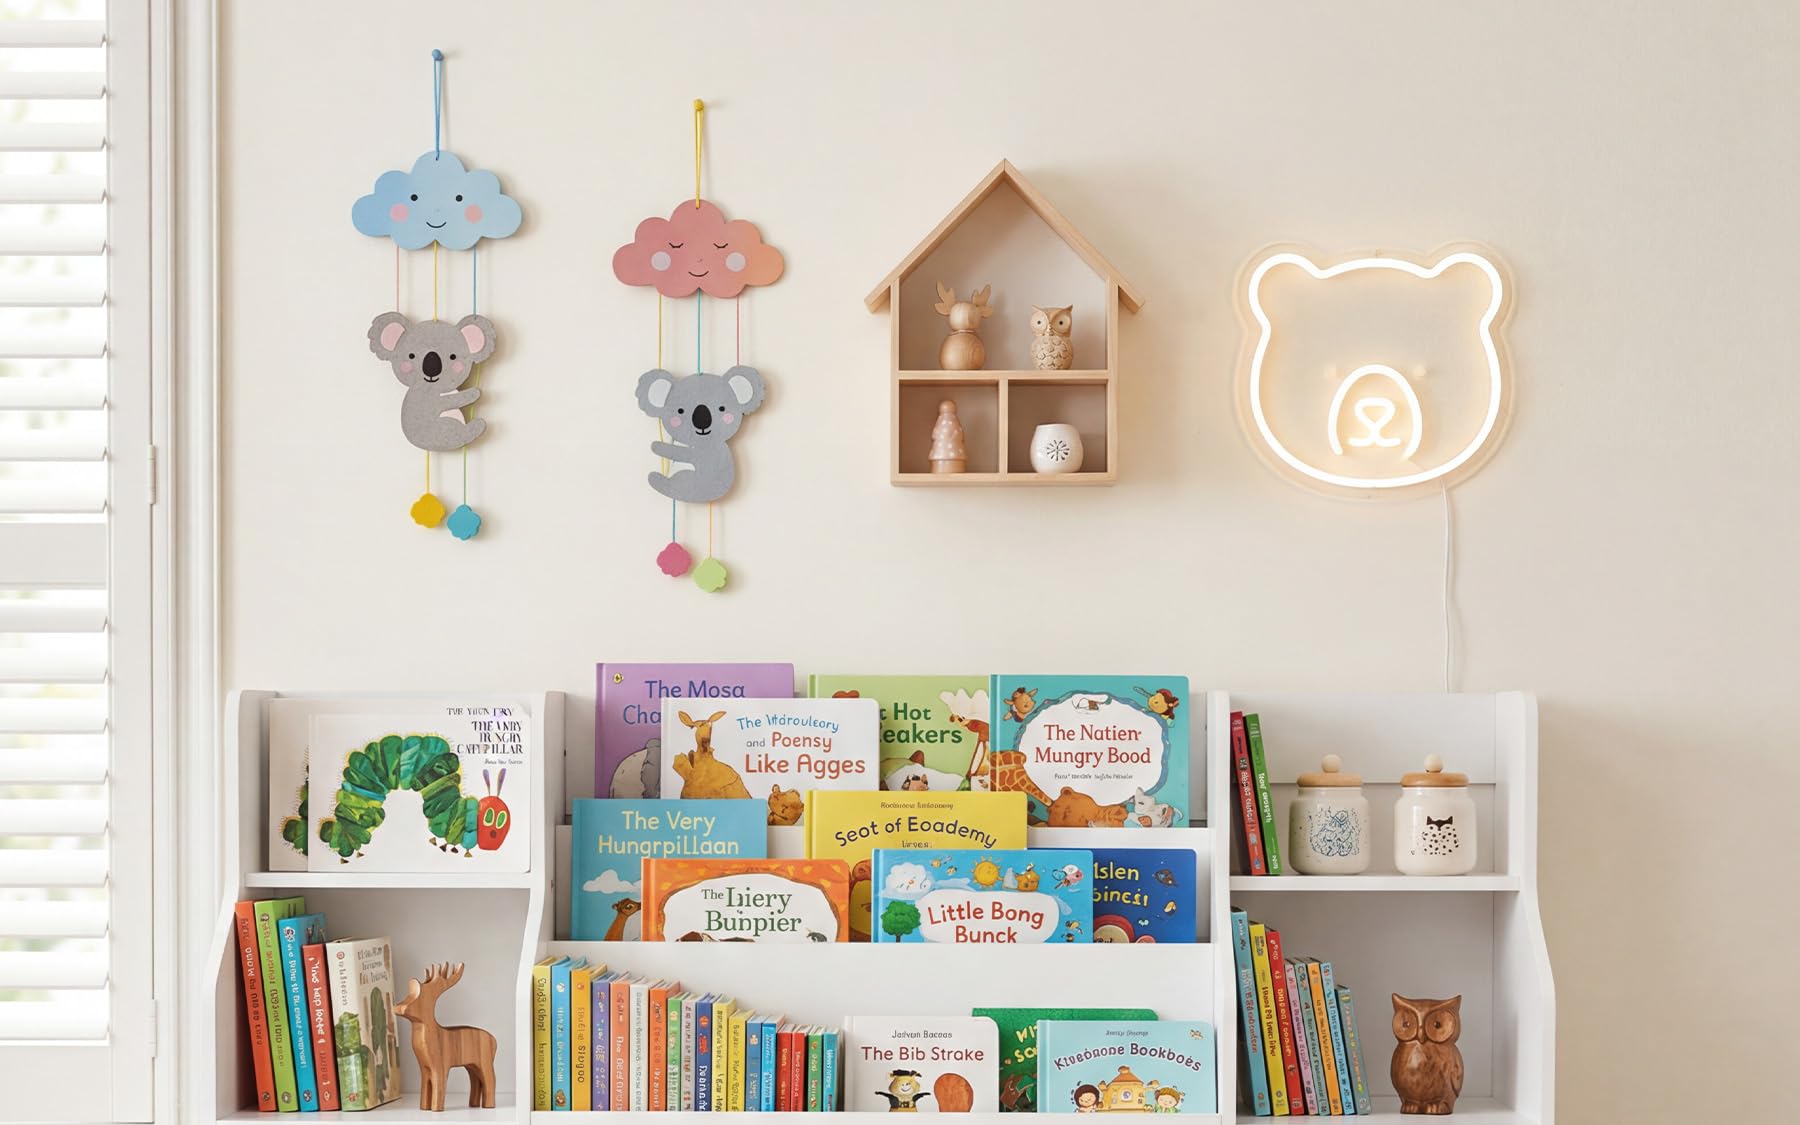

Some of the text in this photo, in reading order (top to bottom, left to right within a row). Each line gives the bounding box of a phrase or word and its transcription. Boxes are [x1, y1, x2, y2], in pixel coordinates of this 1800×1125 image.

[645, 680, 745, 699] The Mosa
[893, 702, 932, 721] Hot
[737, 717, 762, 731] The
[880, 722, 963, 744] eakers
[1044, 724, 1076, 741] The
[746, 731, 832, 753] and Poensy
[744, 753, 867, 780] Like Agges
[1034, 746, 1152, 769] Mungry Bood
[621, 810, 716, 838] The Very
[834, 815, 998, 850] Seot of Eoademy
[701, 889, 724, 900] The
[927, 900, 1045, 930] Little Bong
[954, 924, 1018, 944] Bunck
[861, 1046, 985, 1061] The Bib Strake
